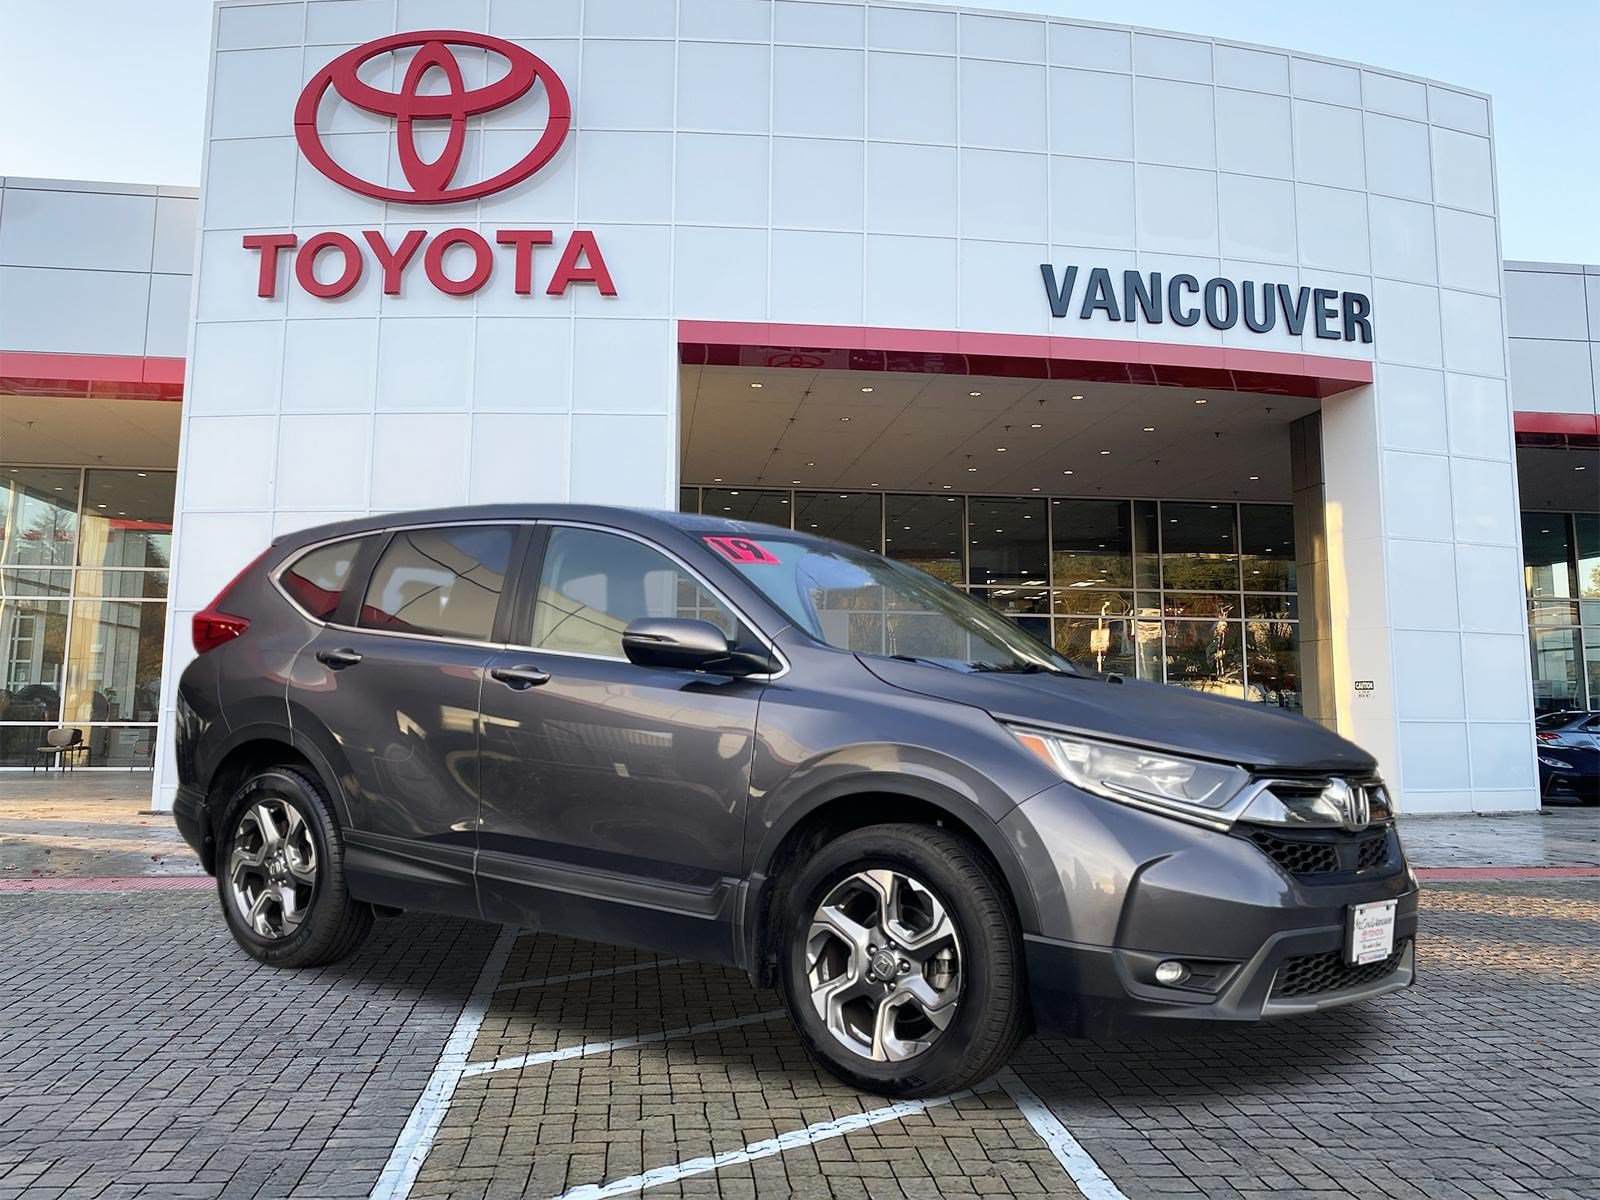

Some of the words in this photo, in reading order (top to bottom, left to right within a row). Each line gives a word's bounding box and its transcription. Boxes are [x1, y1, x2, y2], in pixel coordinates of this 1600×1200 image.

[243, 228, 618, 299] TOYOTA
[1040, 264, 1373, 344] VANCOUVER
[709, 538, 767, 561] 19
